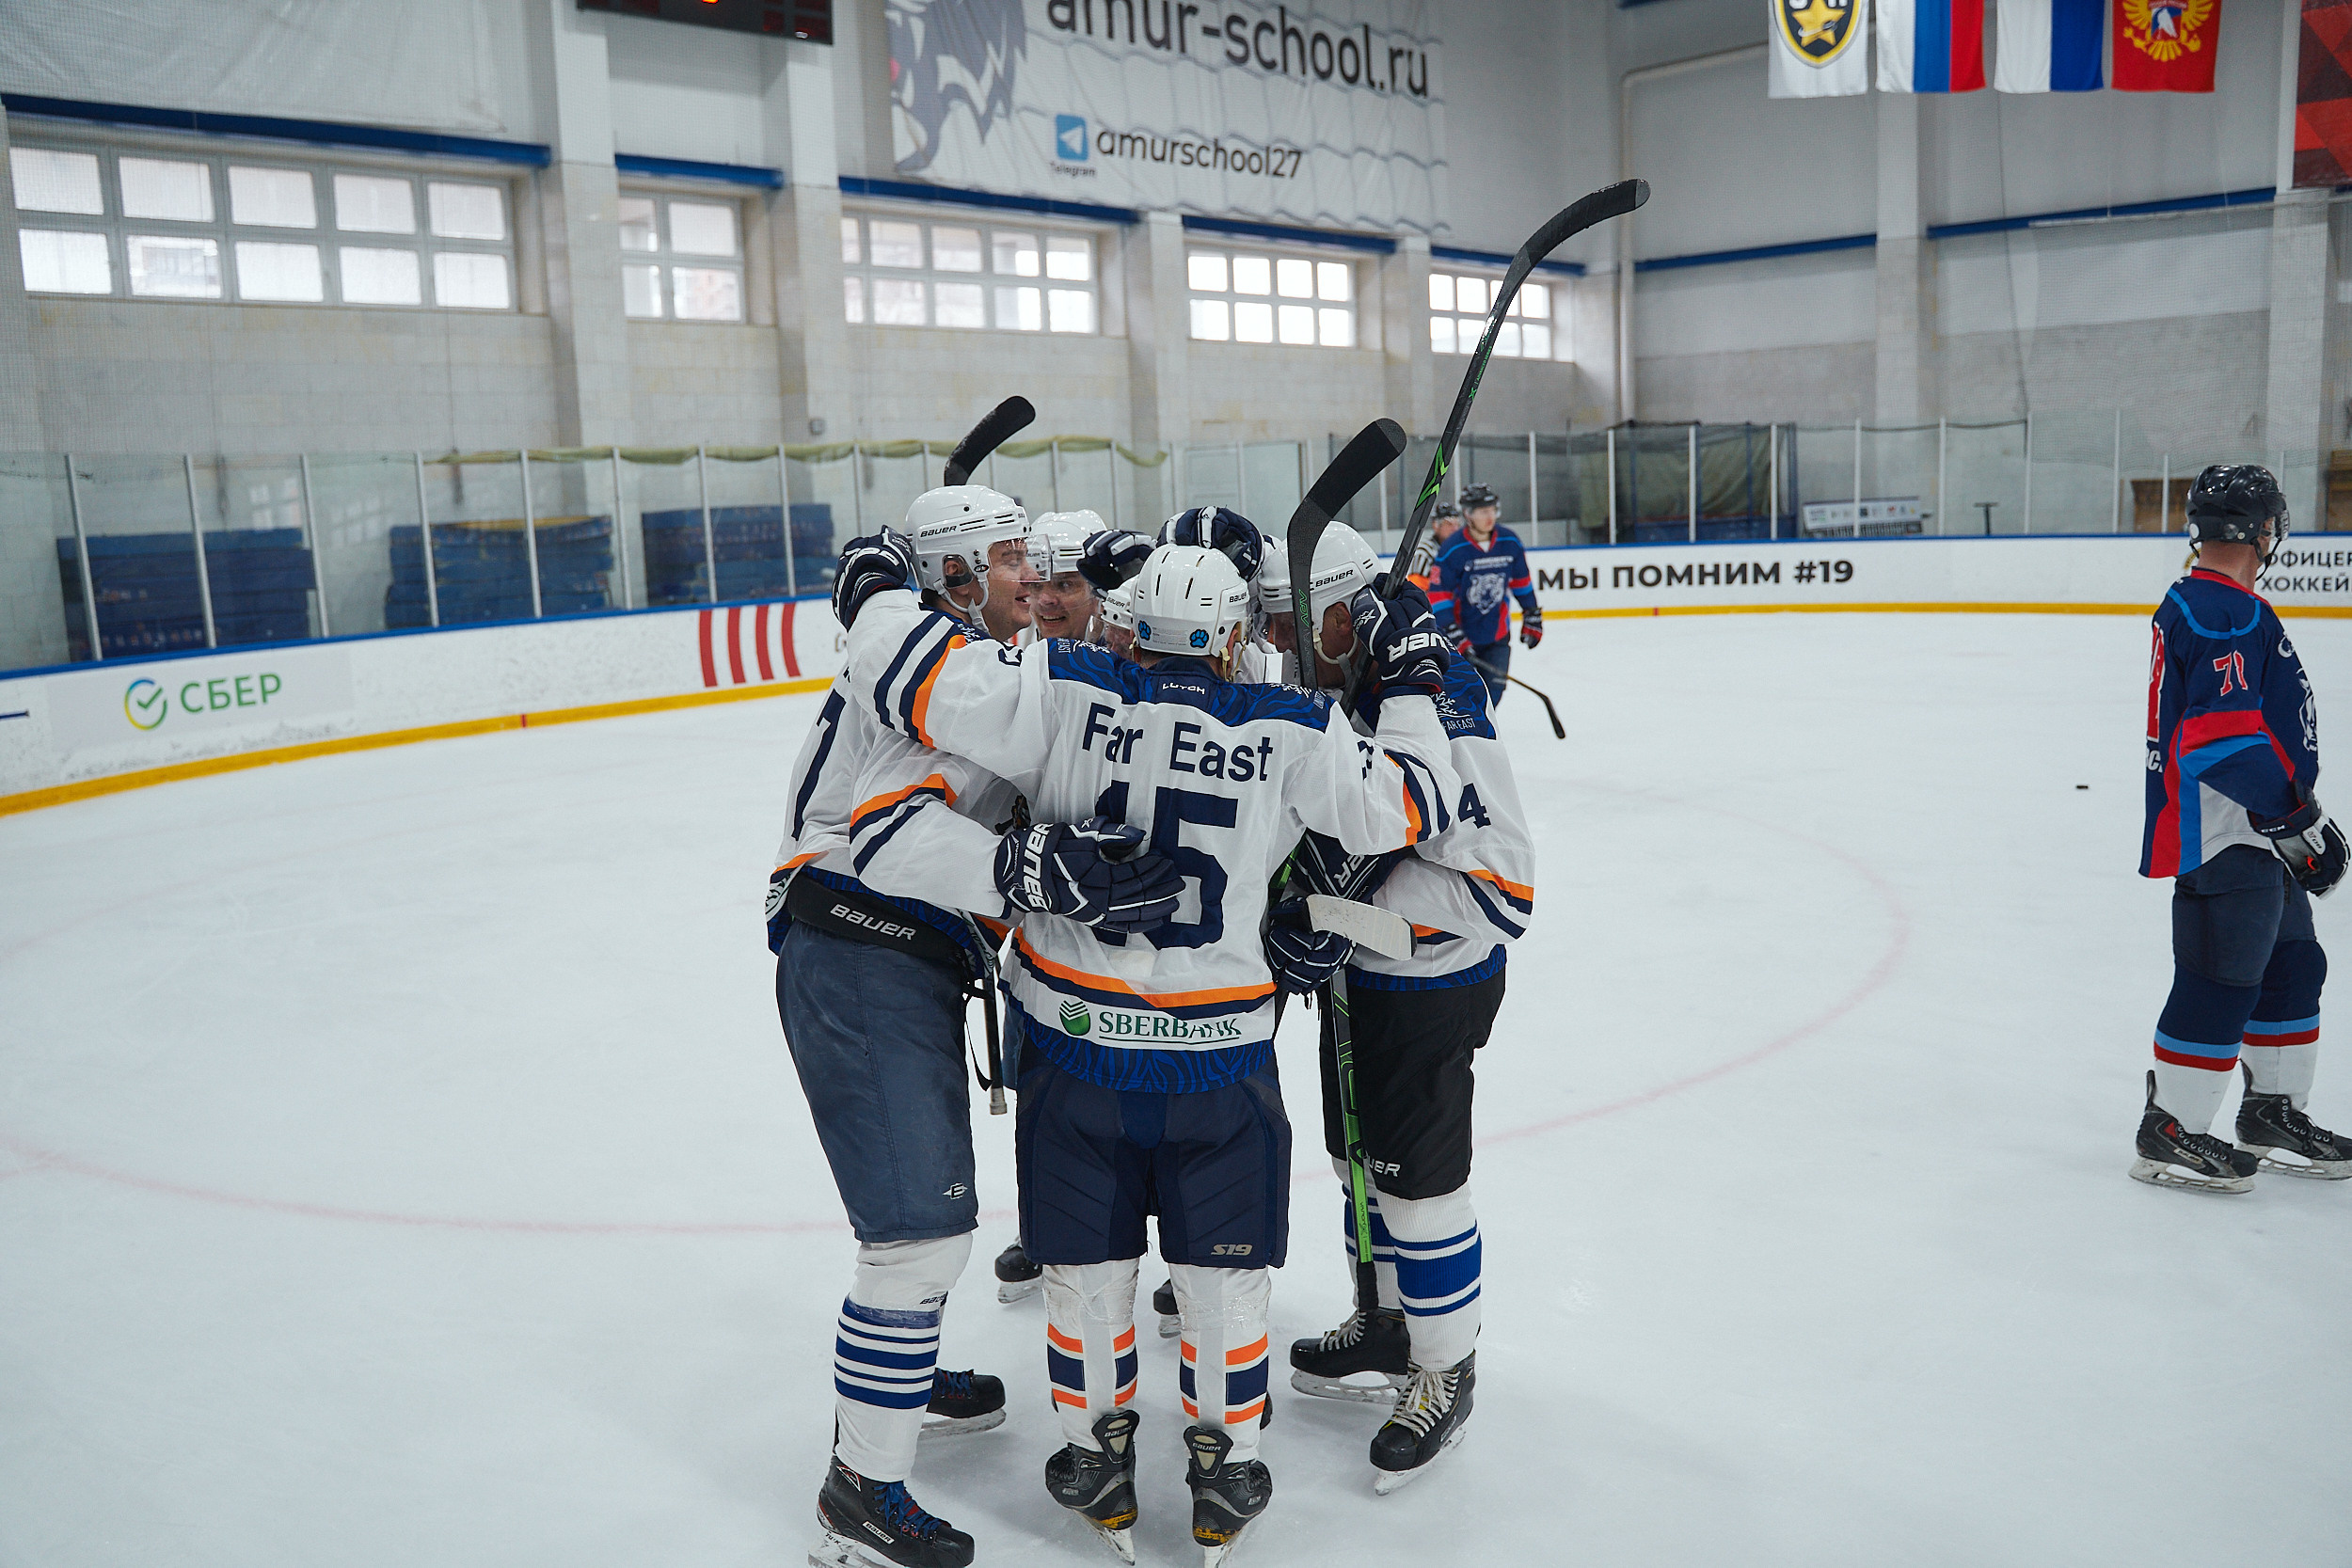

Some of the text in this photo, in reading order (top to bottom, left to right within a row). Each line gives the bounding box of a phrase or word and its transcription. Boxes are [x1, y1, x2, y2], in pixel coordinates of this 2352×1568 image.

[1048, 0, 1427, 99] amur-school.ru
[1096, 130, 1301, 179] amurschool27
[920, 525, 957, 538] BAUER
[1315, 569, 1354, 588] BAUER
[1538, 560, 1854, 591] МЫ ПОМНИМ #19
[1387, 632, 1450, 663] UER
[180, 673, 281, 713] СБЕР
[1457, 718, 1476, 730] EAST
[1081, 702, 1273, 782] Far East
[1023, 822, 1055, 912] BAUER
[829, 903, 917, 941] BAUER
[1098, 1010, 1242, 1039] SBERBANK
[1369, 1158, 1400, 1177] UER
[1210, 1243, 1253, 1256] S19
[865, 1522, 891, 1544] BAUER
